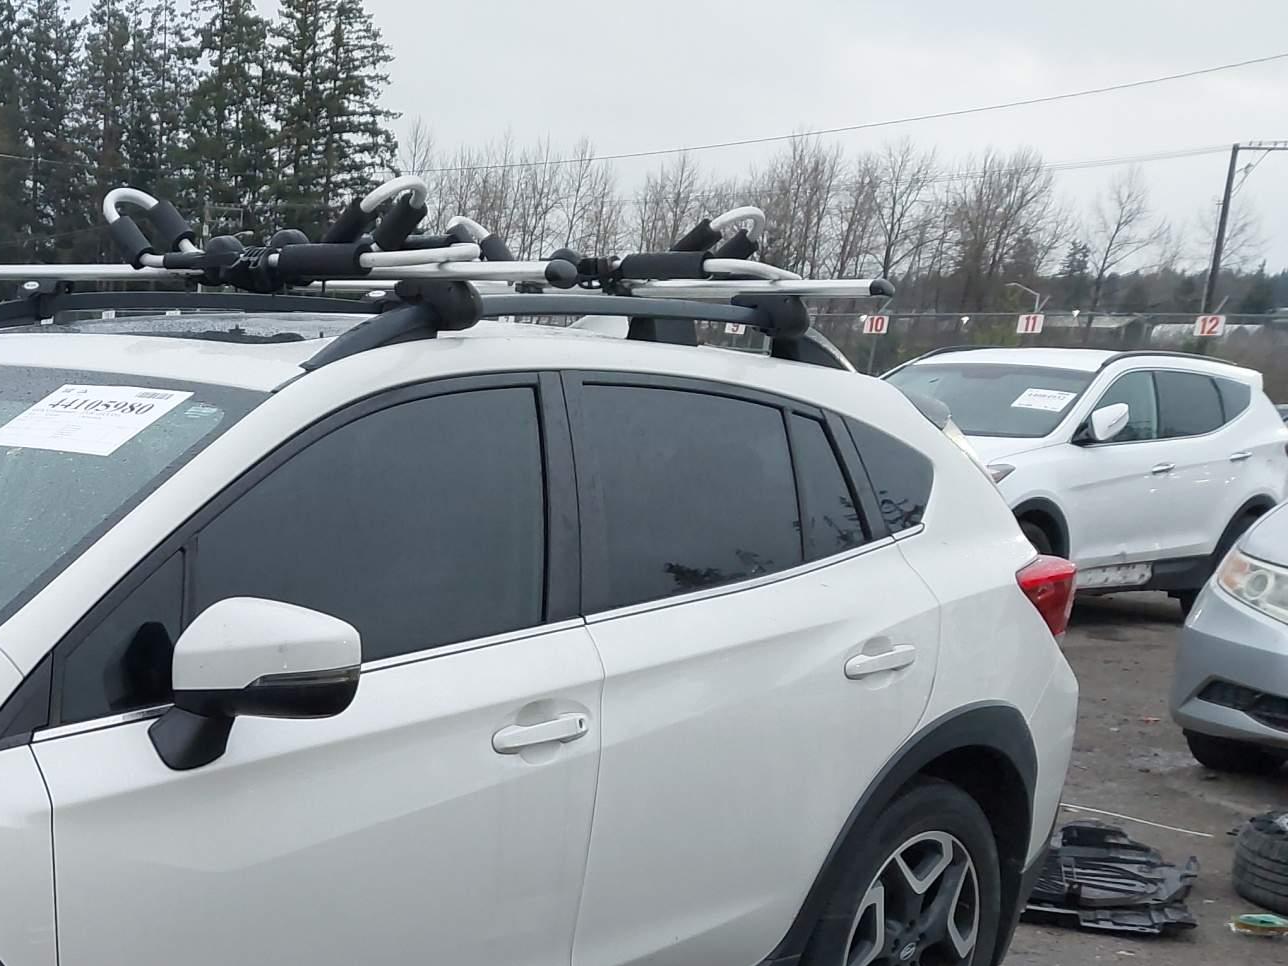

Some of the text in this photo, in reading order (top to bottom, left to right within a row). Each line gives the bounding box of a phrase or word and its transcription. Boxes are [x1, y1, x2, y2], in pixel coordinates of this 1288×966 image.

[869, 316, 885, 332] 10
[1024, 315, 1038, 332] 11
[1200, 316, 1220, 335] 12
[48, 397, 155, 416] 44105980
